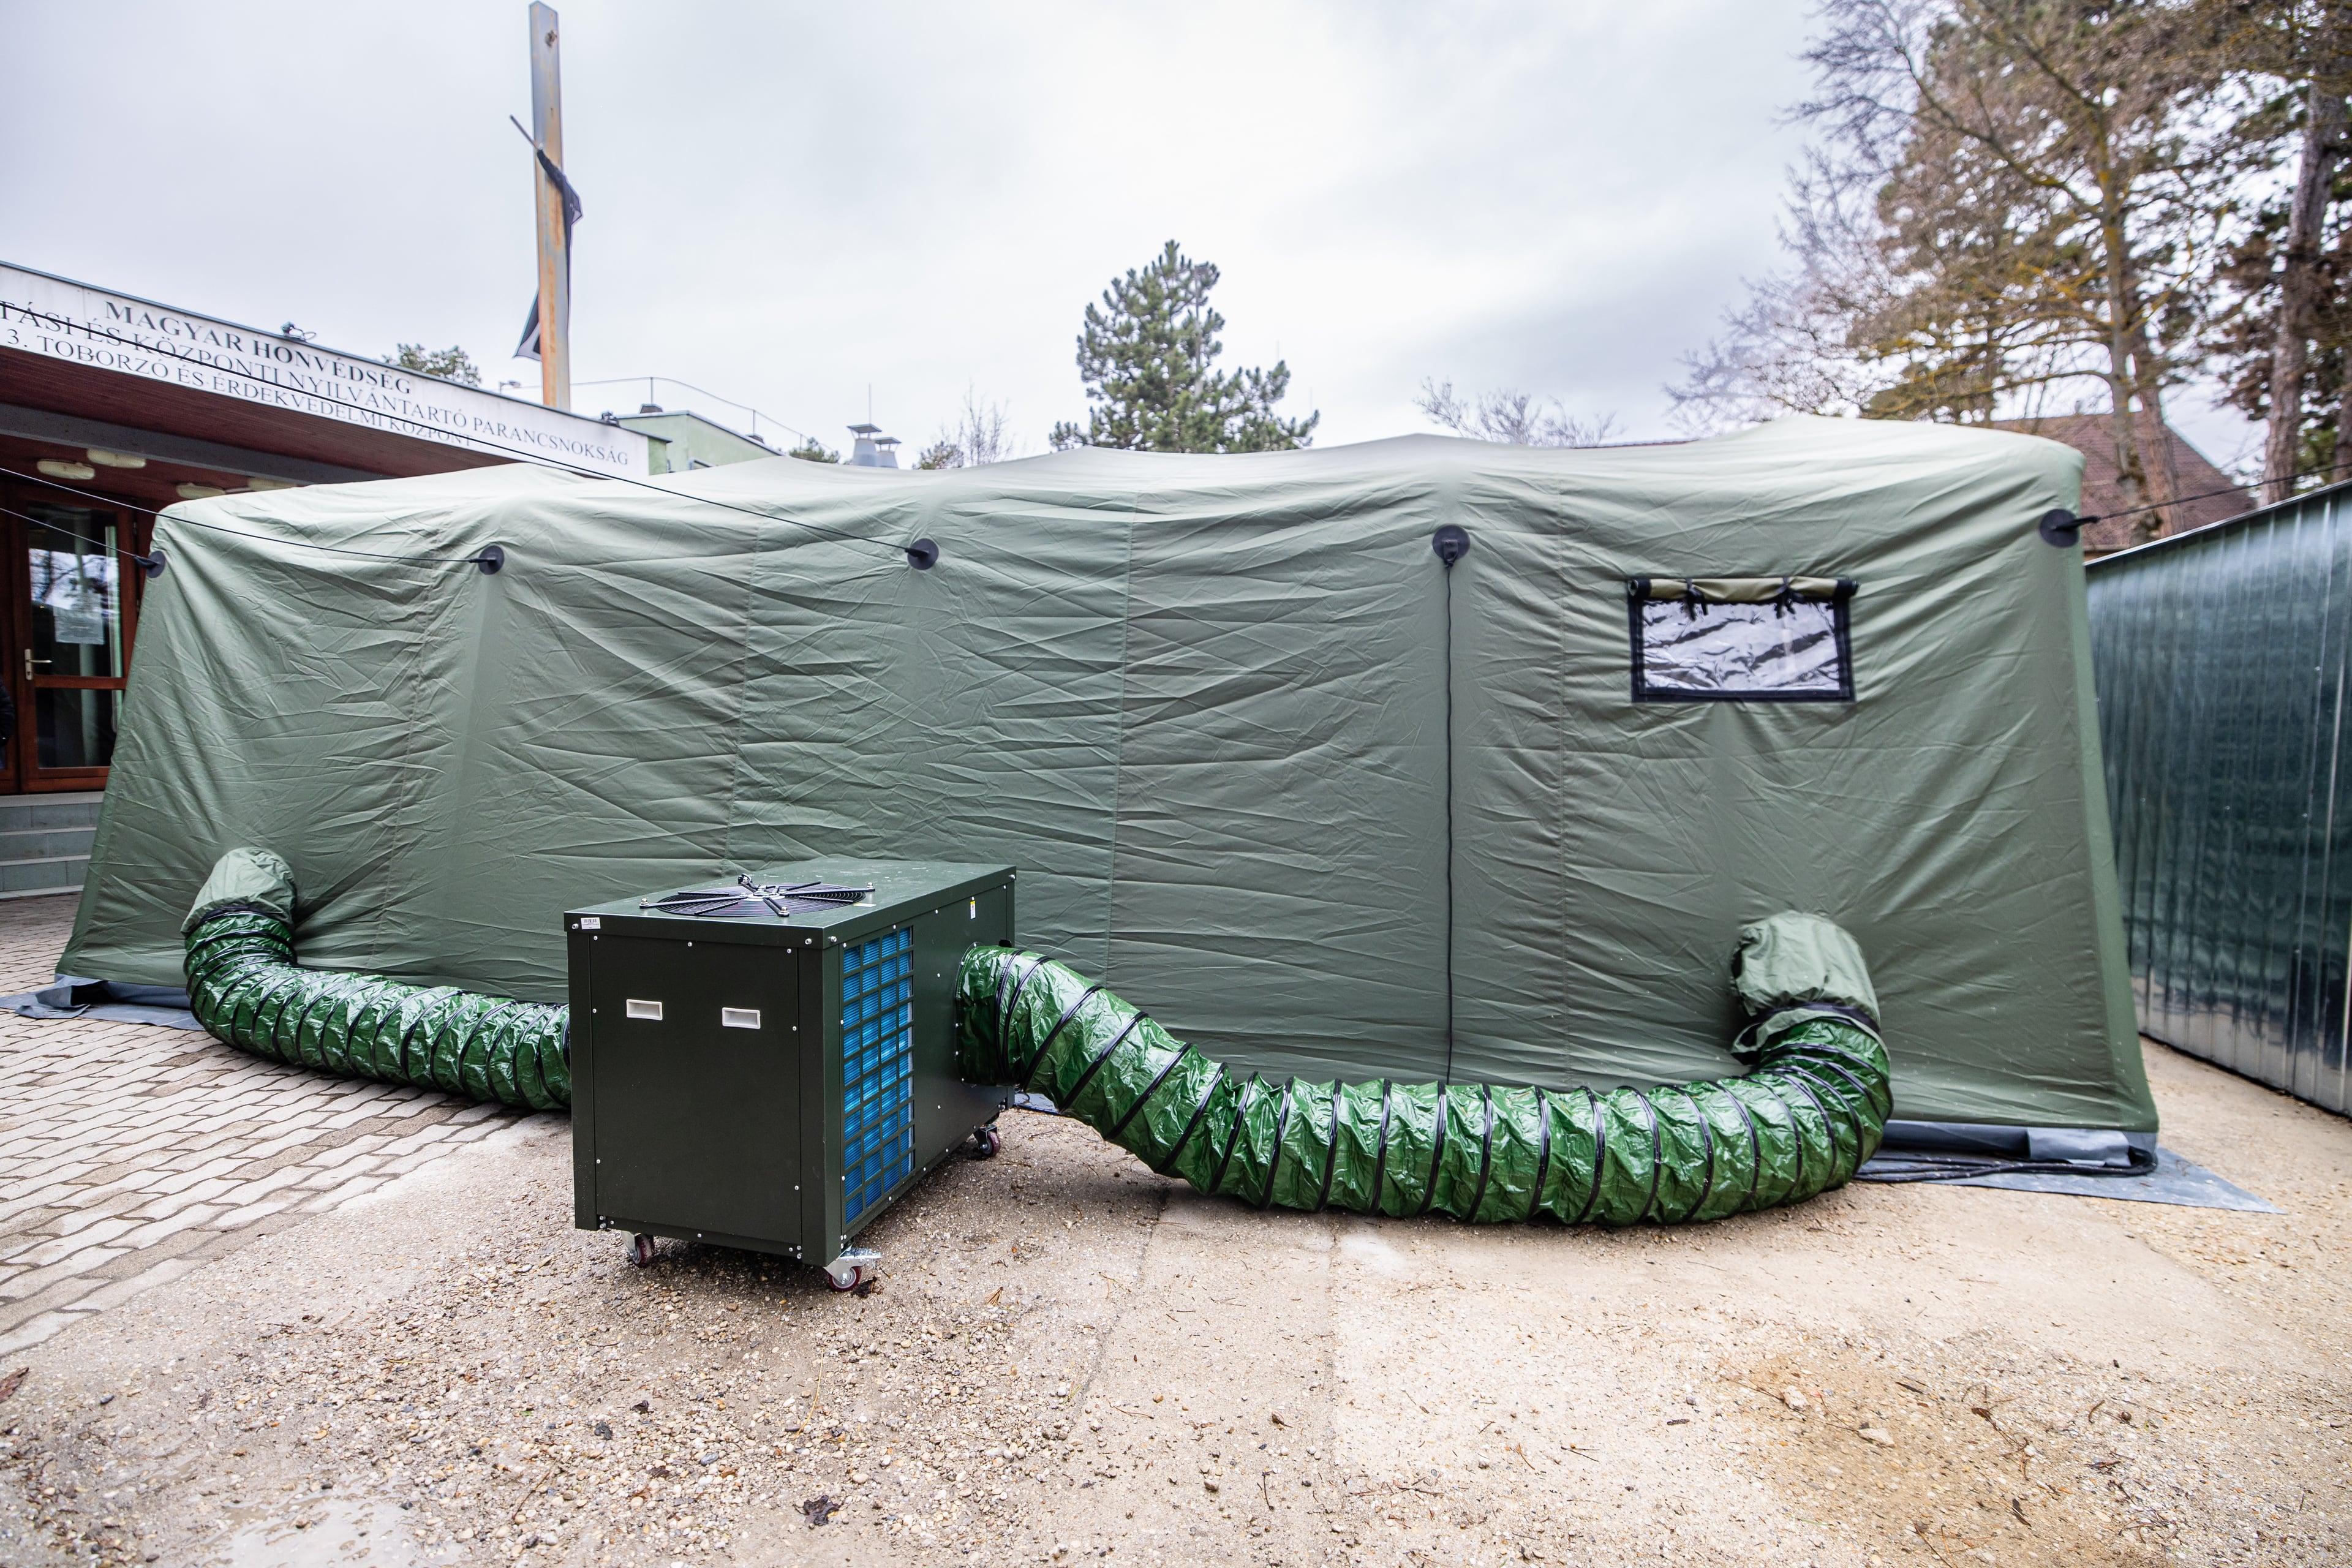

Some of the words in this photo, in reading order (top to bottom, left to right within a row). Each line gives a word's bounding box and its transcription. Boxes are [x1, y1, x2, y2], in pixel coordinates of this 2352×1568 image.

[7, 329, 28, 347] 3.
[37, 335, 168, 378] TOBORZÓ
[177, 364, 204, 386] ÉS
[85, 318, 122, 347] ÉS
[132, 333, 279, 385] KÖZPONTI
[288, 371, 467, 428] NYILVÁNTARTÓ
[473, 417, 628, 466] PARANCSNOKSÁG
[104, 301, 244, 353] MAGYAR
[252, 339, 411, 394] HONVÉDSÉG
